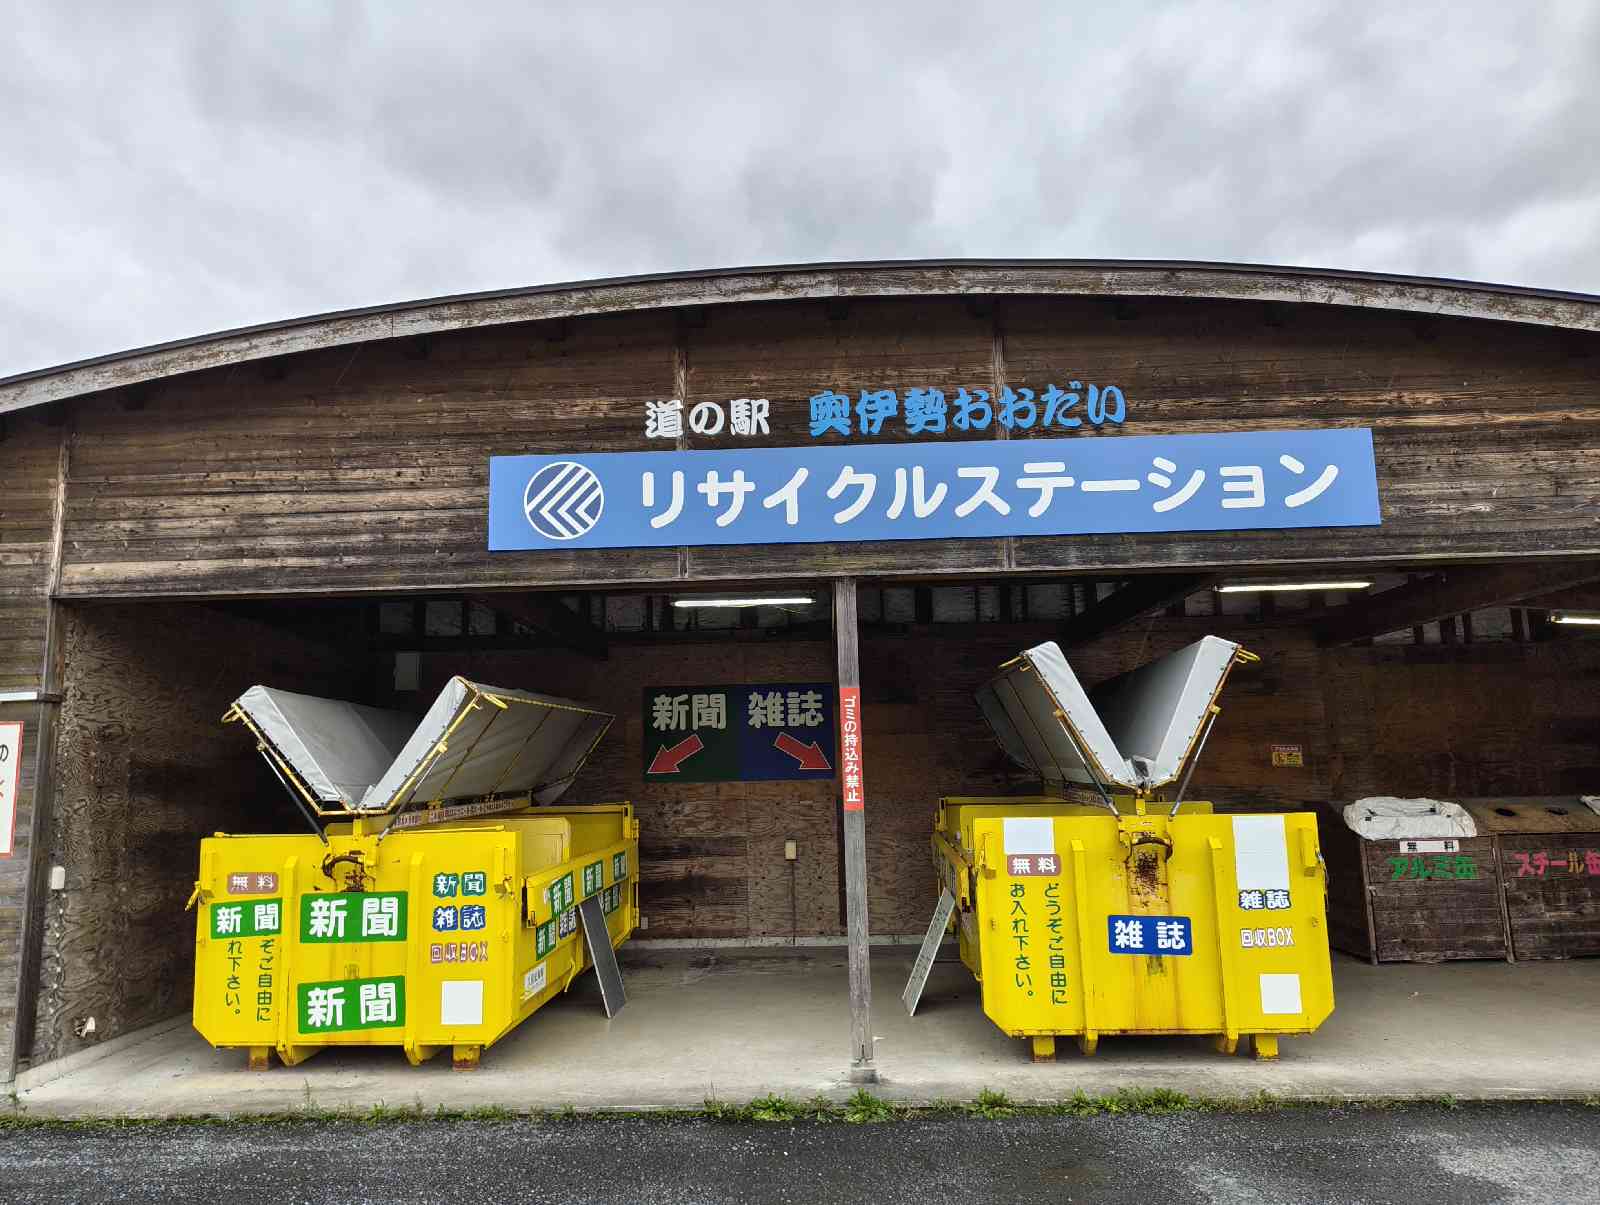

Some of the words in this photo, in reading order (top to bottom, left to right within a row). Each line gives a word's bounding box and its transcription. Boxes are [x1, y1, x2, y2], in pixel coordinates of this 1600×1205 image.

[645, 398, 770, 438] 道の駅
[808, 381, 1127, 438] 奥伊勢おおだい
[641, 453, 1339, 529] リサイクルステーション
[652, 693, 727, 731] 新聞
[748, 691, 824, 728] 雑誌
[844, 696, 860, 802] ゴミの持込み禁止
[230, 874, 274, 893] 無料
[1012, 857, 1057, 874] 無料
[435, 873, 485, 896] 新聞
[1239, 890, 1291, 909] 雑誌
[217, 903, 279, 935] 新聞
[309, 896, 399, 939] 新聞
[435, 906, 485, 929] 雑誌
[1114, 920, 1186, 950] 雑誌
[1010, 883, 1034, 997] お入れ下さい。
[1240, 927, 1295, 947] 回収BOX
[307, 982, 397, 1028] 新聞
